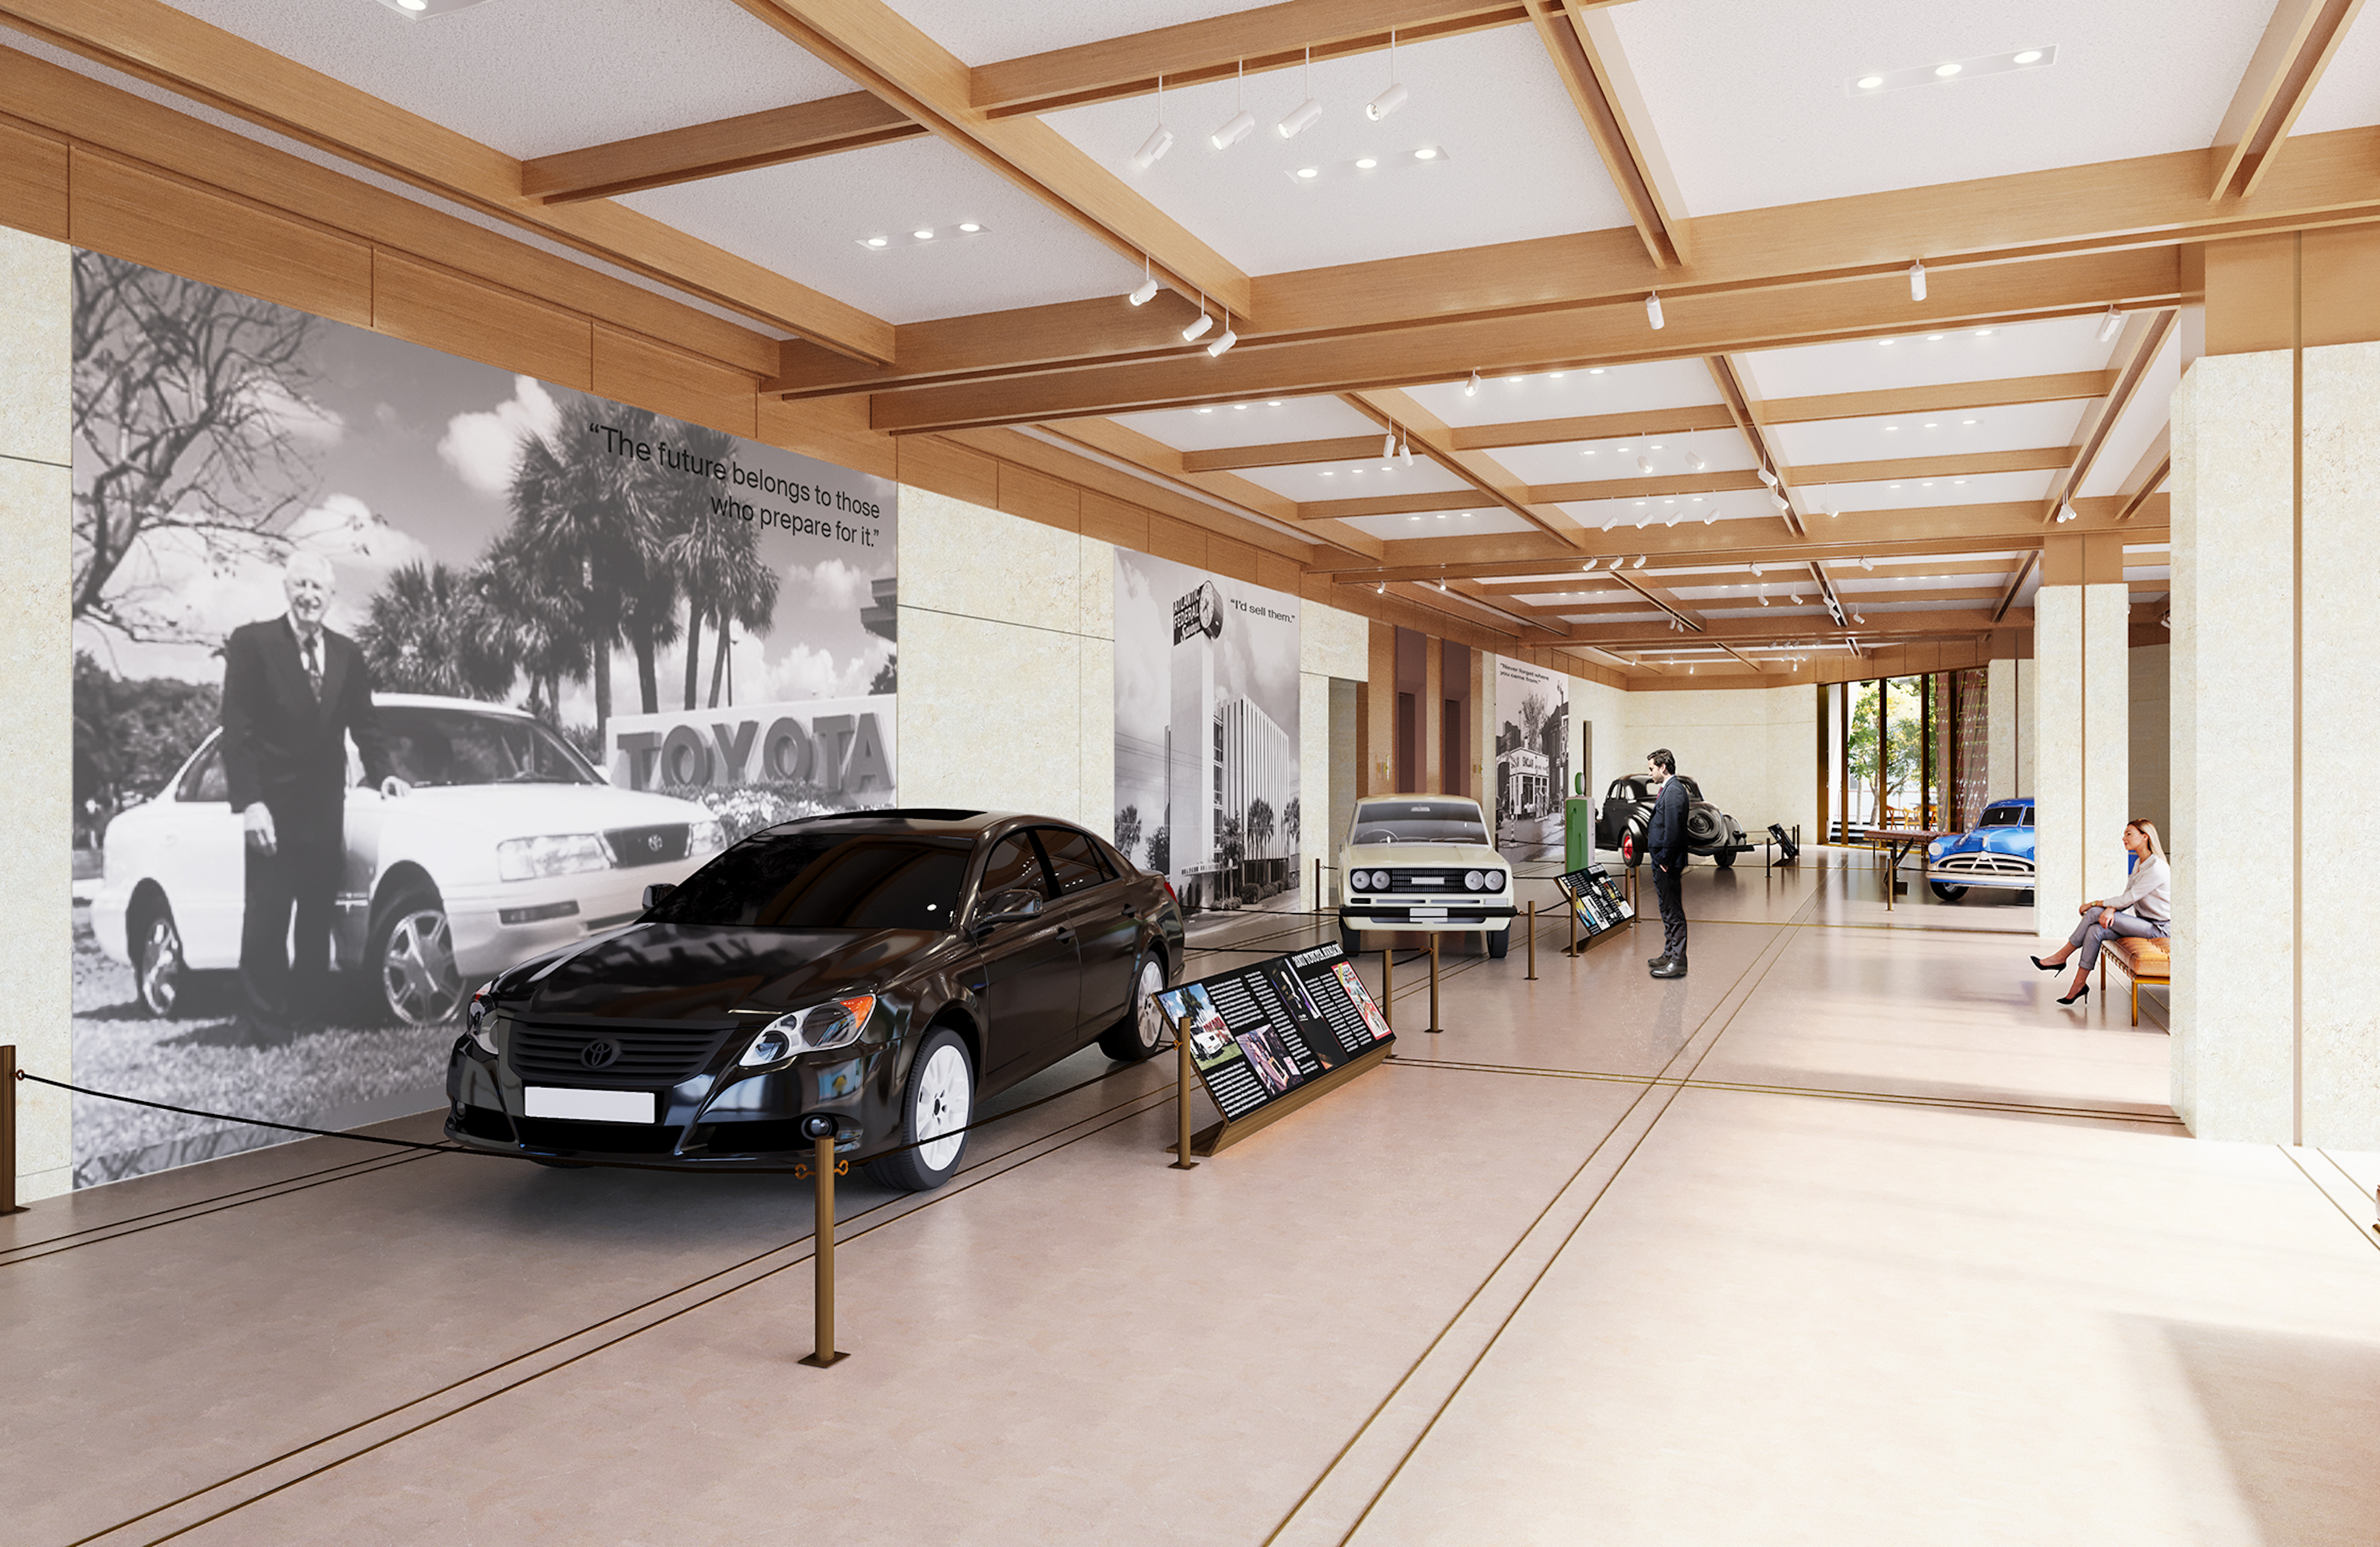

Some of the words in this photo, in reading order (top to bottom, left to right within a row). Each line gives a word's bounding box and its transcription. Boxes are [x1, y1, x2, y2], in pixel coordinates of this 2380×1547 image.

[590, 422, 651, 462] “The
[657, 442, 727, 480] future
[733, 461, 811, 504] belongs
[815, 485, 832, 507] to
[836, 491, 881, 518] those
[710, 495, 755, 521] who
[760, 507, 832, 538] prepare
[835, 521, 857, 544] for
[861, 526, 880, 548] it.”
[1174, 602, 1200, 630] FEDERAL
[1249, 605, 1266, 616] sell
[1268, 609, 1296, 623] them.”
[1510, 673, 1525, 681] came
[1519, 667, 1534, 676] forget
[1535, 673, 1549, 681] where
[617, 712, 894, 791] TOYOTA
